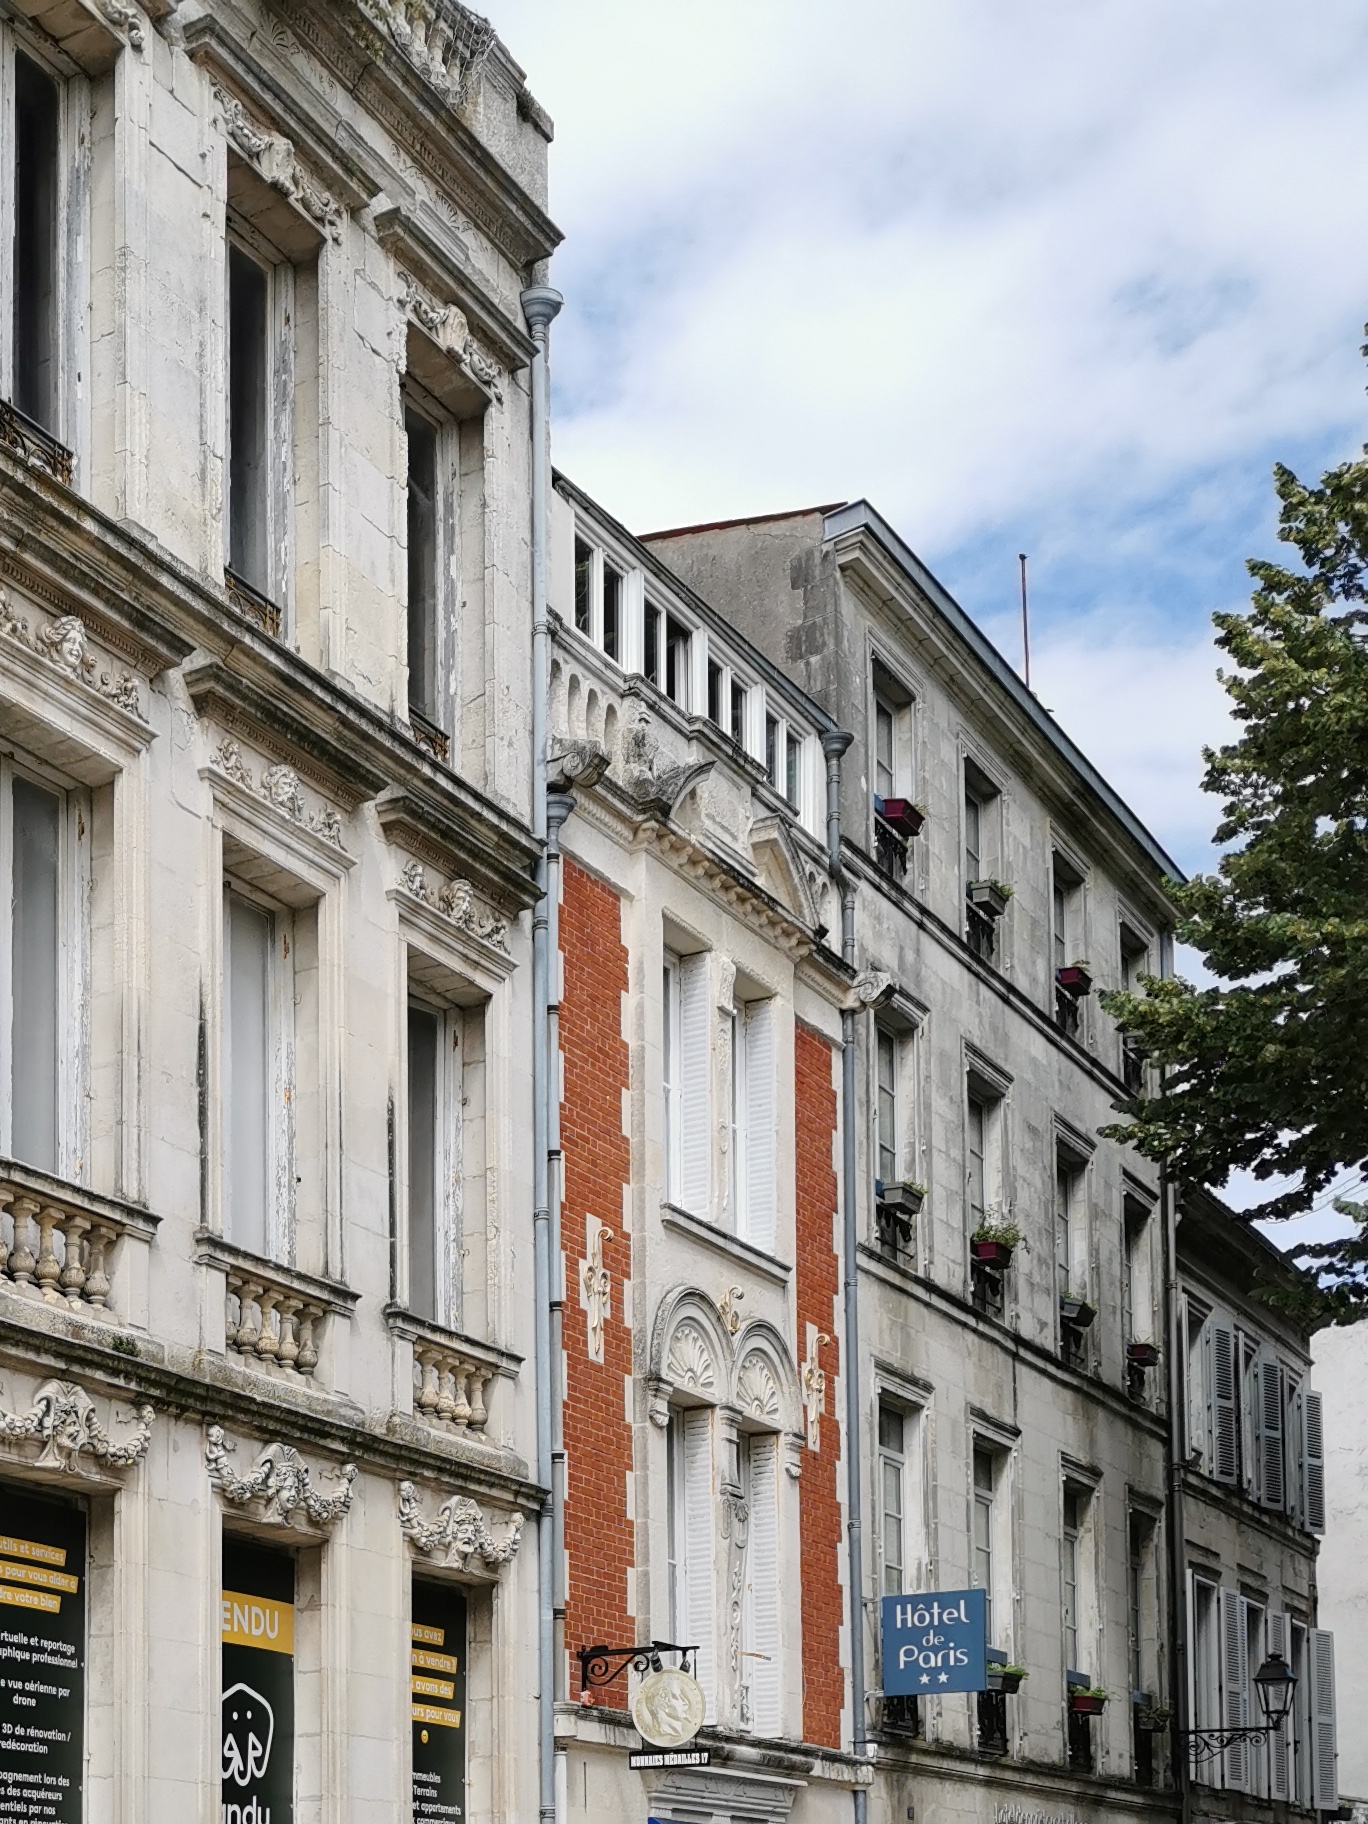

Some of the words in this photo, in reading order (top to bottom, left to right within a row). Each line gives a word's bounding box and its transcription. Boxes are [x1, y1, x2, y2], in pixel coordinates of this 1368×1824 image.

[20, 1545, 30, 1555] et
[32, 1547, 64, 1562] services
[5, 1566, 27, 1579] pour
[28, 1570, 47, 1583] vous
[49, 1573, 69, 1586] aider
[14, 1592, 38, 1606] votre
[40, 1595, 59, 1608] bien
[222, 1600, 280, 1640] ENDU
[895, 1599, 971, 1629] Hôtel
[424, 1629, 442, 1642] avez
[922, 1628, 945, 1647] de
[30, 1636, 39, 1647] et
[40, 1639, 76, 1656] reportage
[32, 1652, 78, 1668] professionnel
[418, 1654, 425, 1665] à
[898, 1641, 969, 1670] Paris
[8, 1679, 23, 1690] vue
[24, 1680, 58, 1695] aérienne
[58, 1686, 71, 1699] par
[415, 1680, 439, 1694] avons
[439, 1684, 452, 1695] des
[12, 1693, 37, 1707] drone
[426, 1708, 443, 1722] pour
[444, 1712, 459, 1724] vous
[2, 1723, 13, 1734] 3D
[15, 1724, 25, 1736] de
[26, 1726, 66, 1742] rénovation
[630, 1754, 664, 1767] MONNAIES
[664, 1751, 701, 1766] MÉDAILLES
[701, 1752, 709, 1764] 17
[44, 1773, 57, 1786] lors
[58, 1775, 70, 1787] des
[7, 1785, 21, 1797] des
[22, 1788, 63, 1802] acquéreurs
[413, 1785, 438, 1798] Terrains
[29, 1805, 42, 1817] par
[43, 1806, 56, 1816] nos
[420, 1802, 462, 1815] appartements
